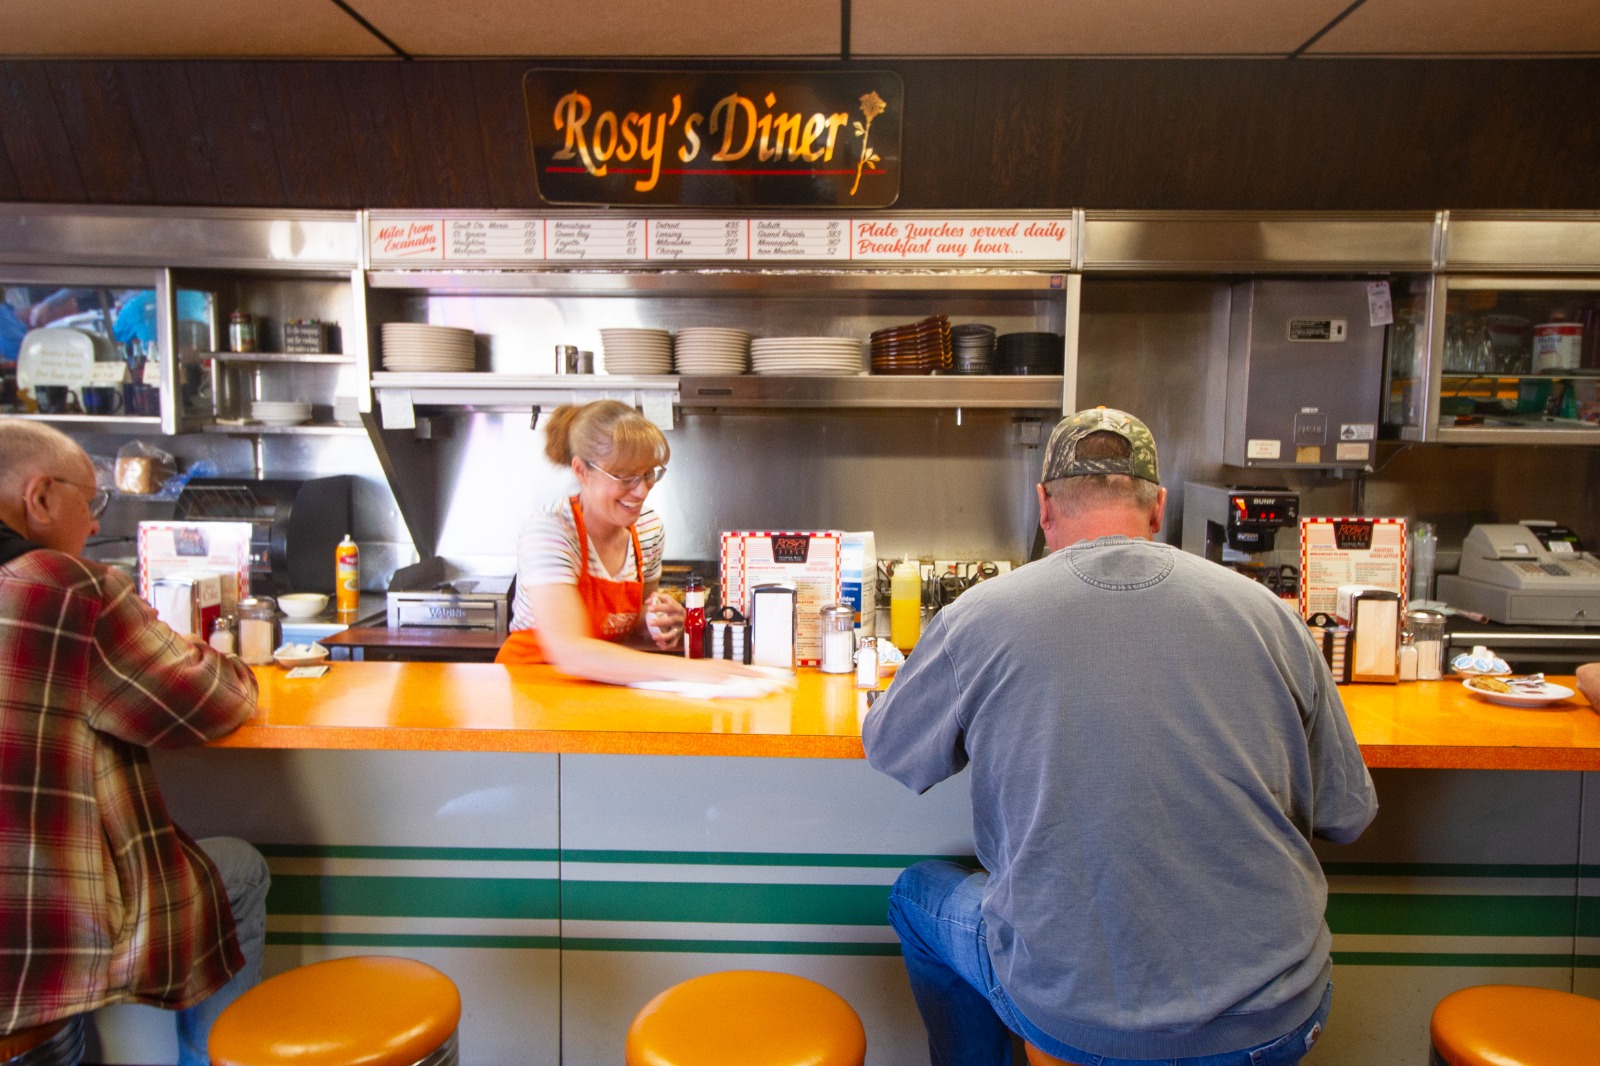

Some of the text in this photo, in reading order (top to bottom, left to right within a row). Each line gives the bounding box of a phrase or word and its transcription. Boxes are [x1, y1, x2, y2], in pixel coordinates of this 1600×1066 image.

[552, 89, 848, 192] Rosy's Diner
[373, 223, 434, 243] Miles from
[857, 222, 1067, 242] Plate Lunches served daily
[384, 234, 436, 253] Escanaba
[857, 239, 932, 257] Breakfast
[936, 243, 968, 257] any
